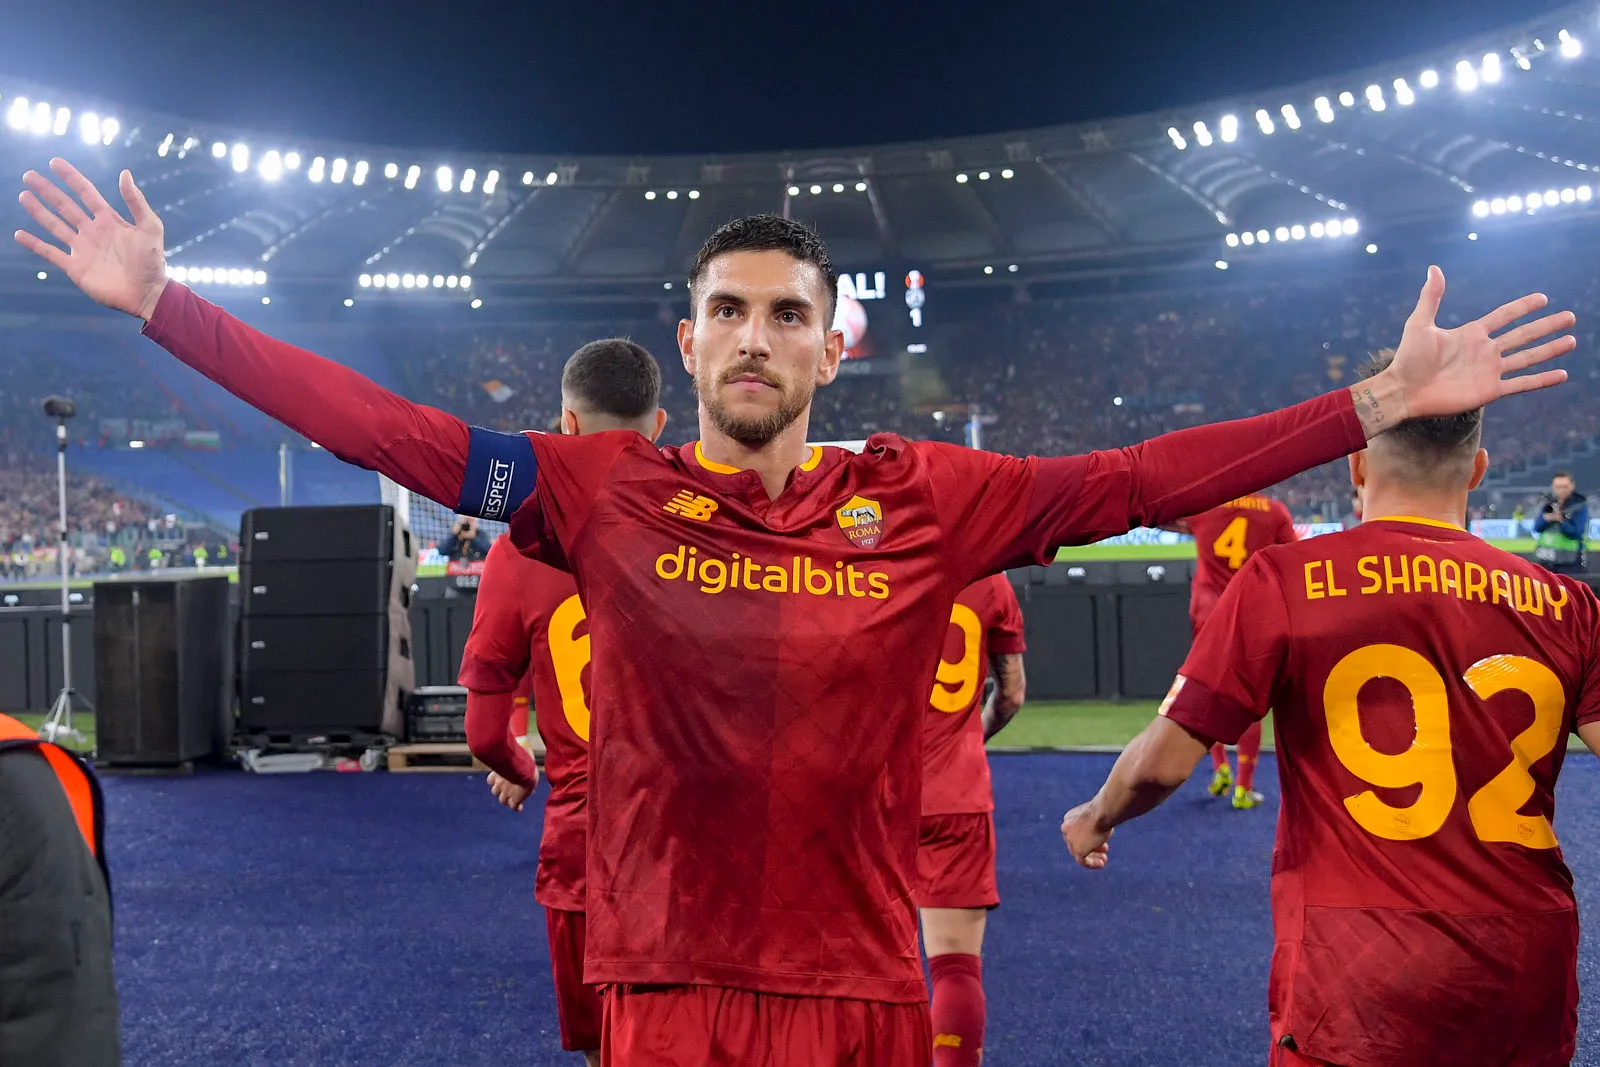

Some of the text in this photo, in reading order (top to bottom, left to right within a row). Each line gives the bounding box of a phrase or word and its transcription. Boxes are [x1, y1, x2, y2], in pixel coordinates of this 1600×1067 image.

[483, 459, 509, 519] RESPECT
[848, 525, 881, 540] ROMA
[1213, 516, 1247, 569] 4
[655, 545, 890, 600] digitalbits
[1304, 554, 1568, 621] EL SHAARAWY
[930, 603, 982, 713] 9
[1323, 644, 1565, 849] 92
